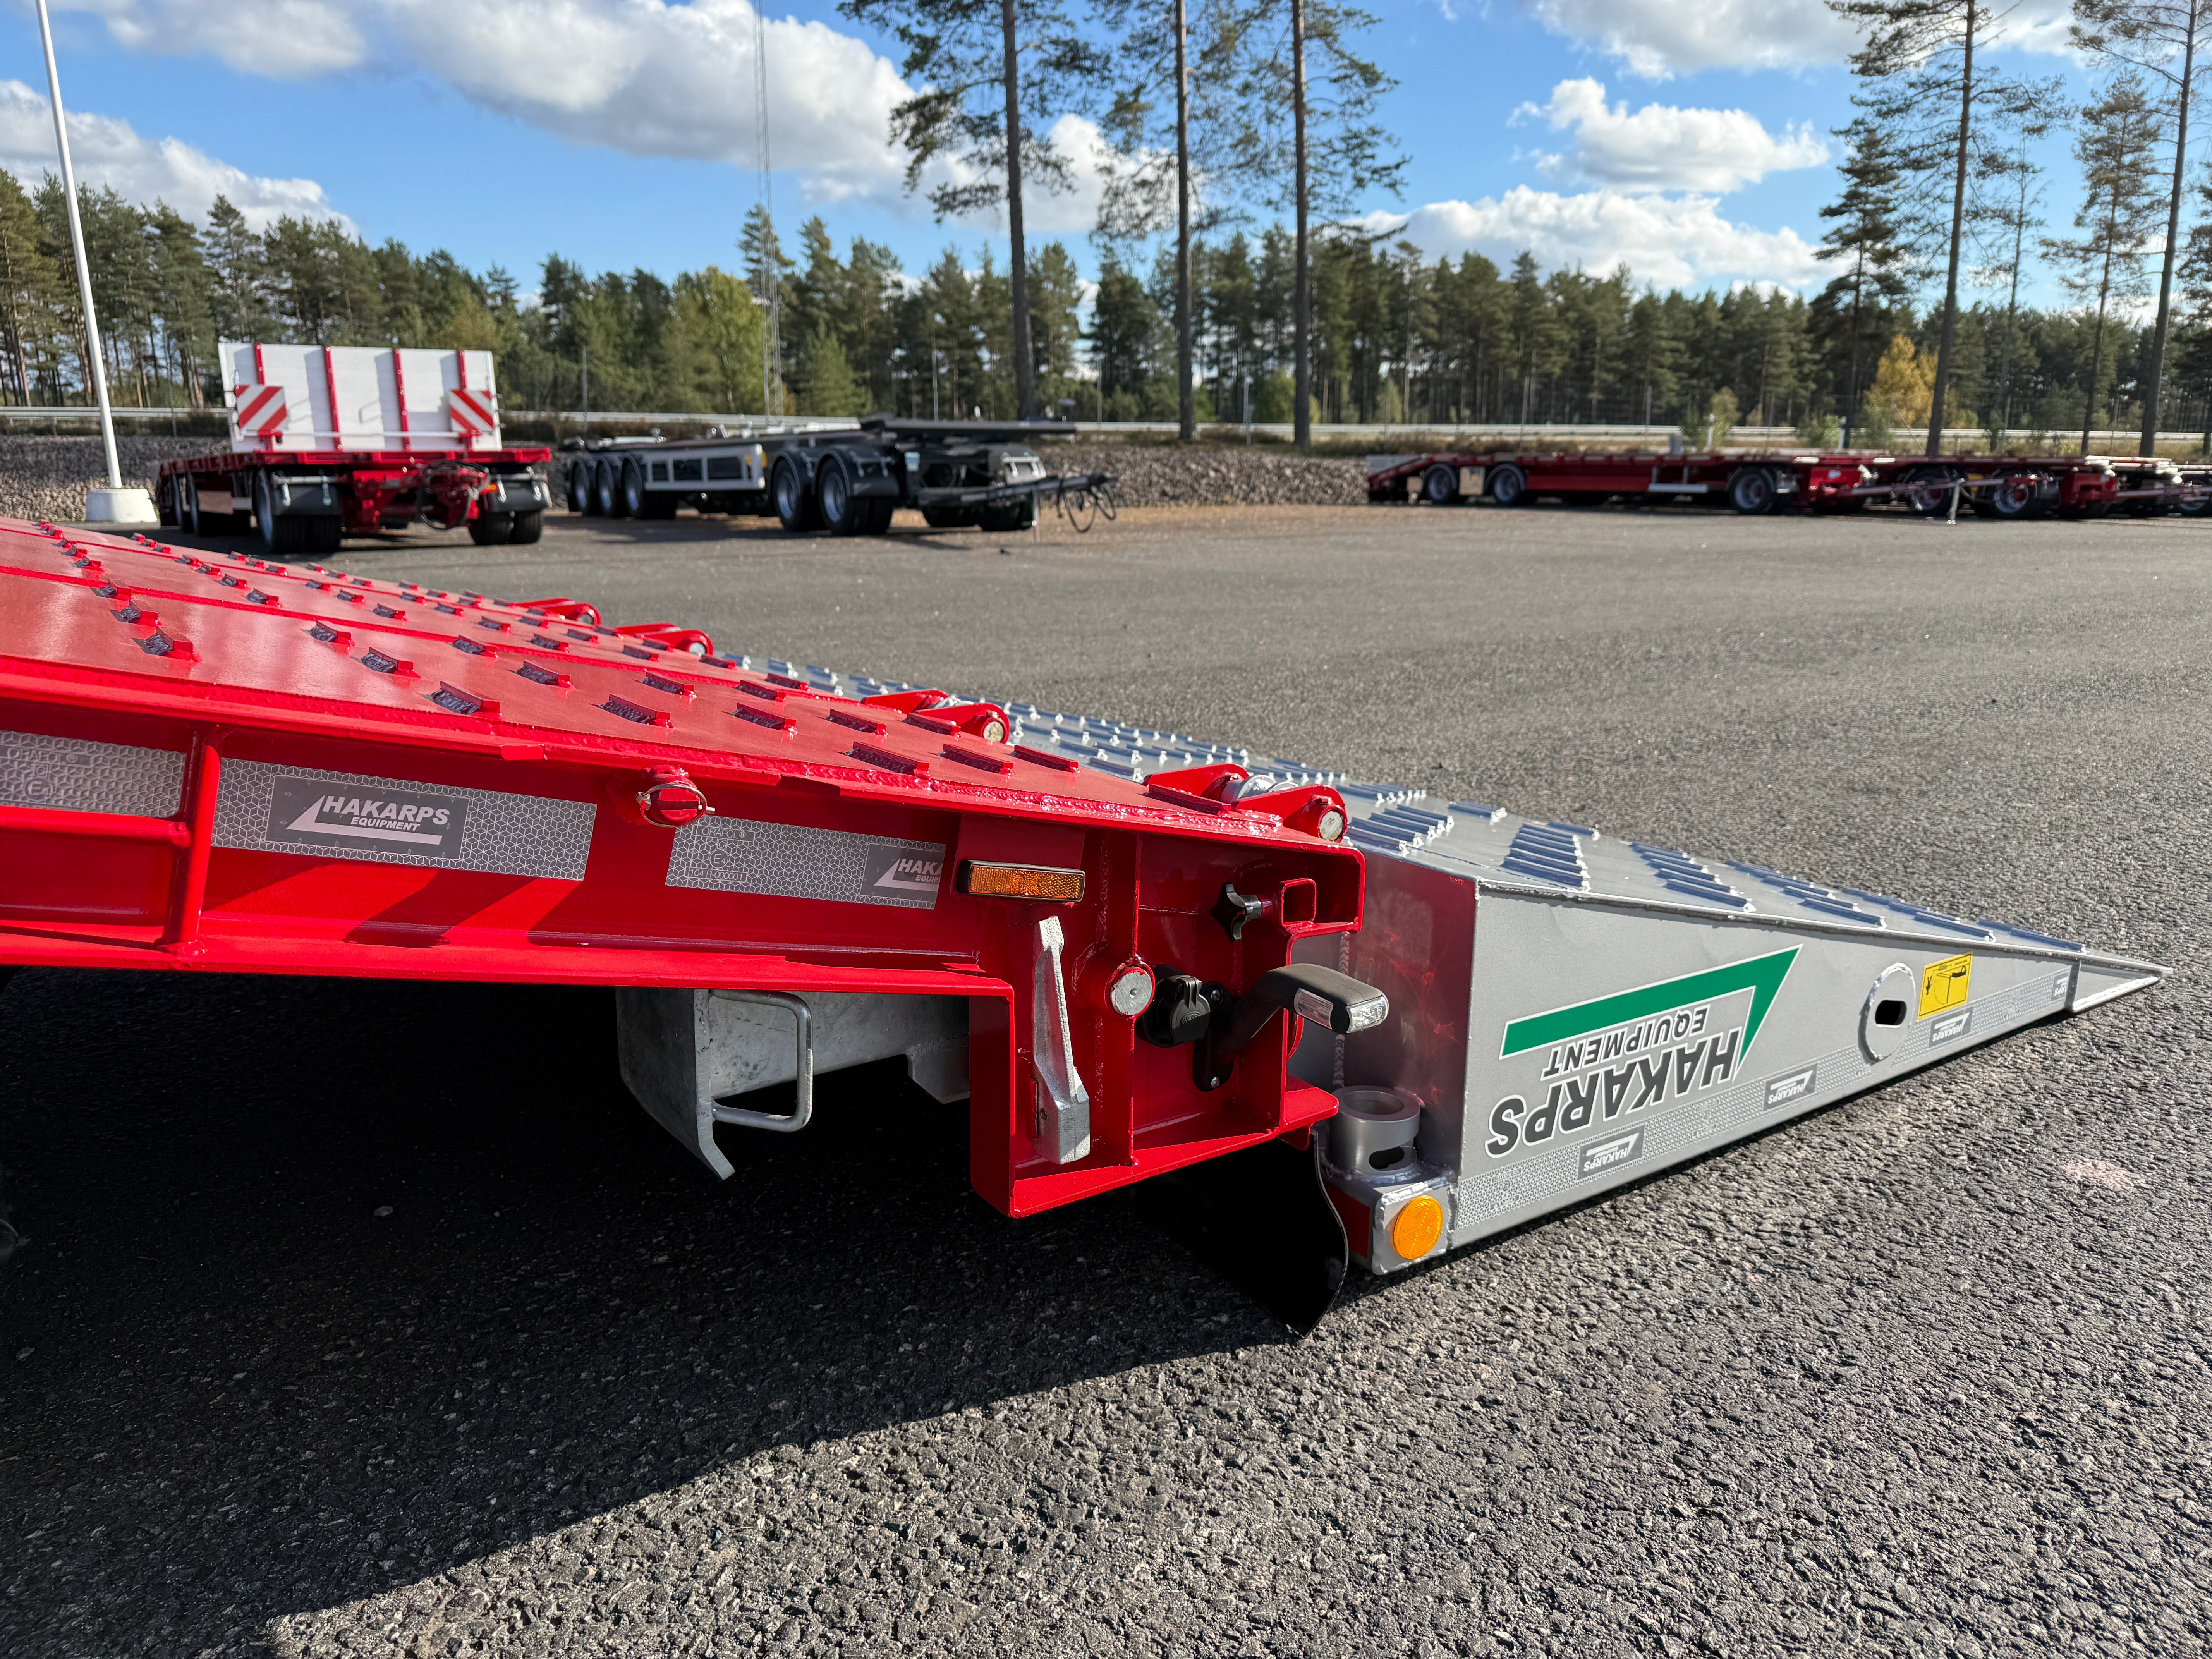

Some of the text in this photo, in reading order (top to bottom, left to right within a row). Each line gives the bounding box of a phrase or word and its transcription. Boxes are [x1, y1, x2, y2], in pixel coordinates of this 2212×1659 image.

[322, 795, 450, 825] HAKARPS
[350, 817, 420, 831] EQUIPMENT
[690, 869, 704, 877] 104
[1540, 1004, 1710, 1081] EQUIPMENT
[1485, 1027, 1742, 1158] HAKARPS
[1768, 1083, 1804, 1104] HAKARPS
[1583, 1147, 1628, 1172] HAKARPS
